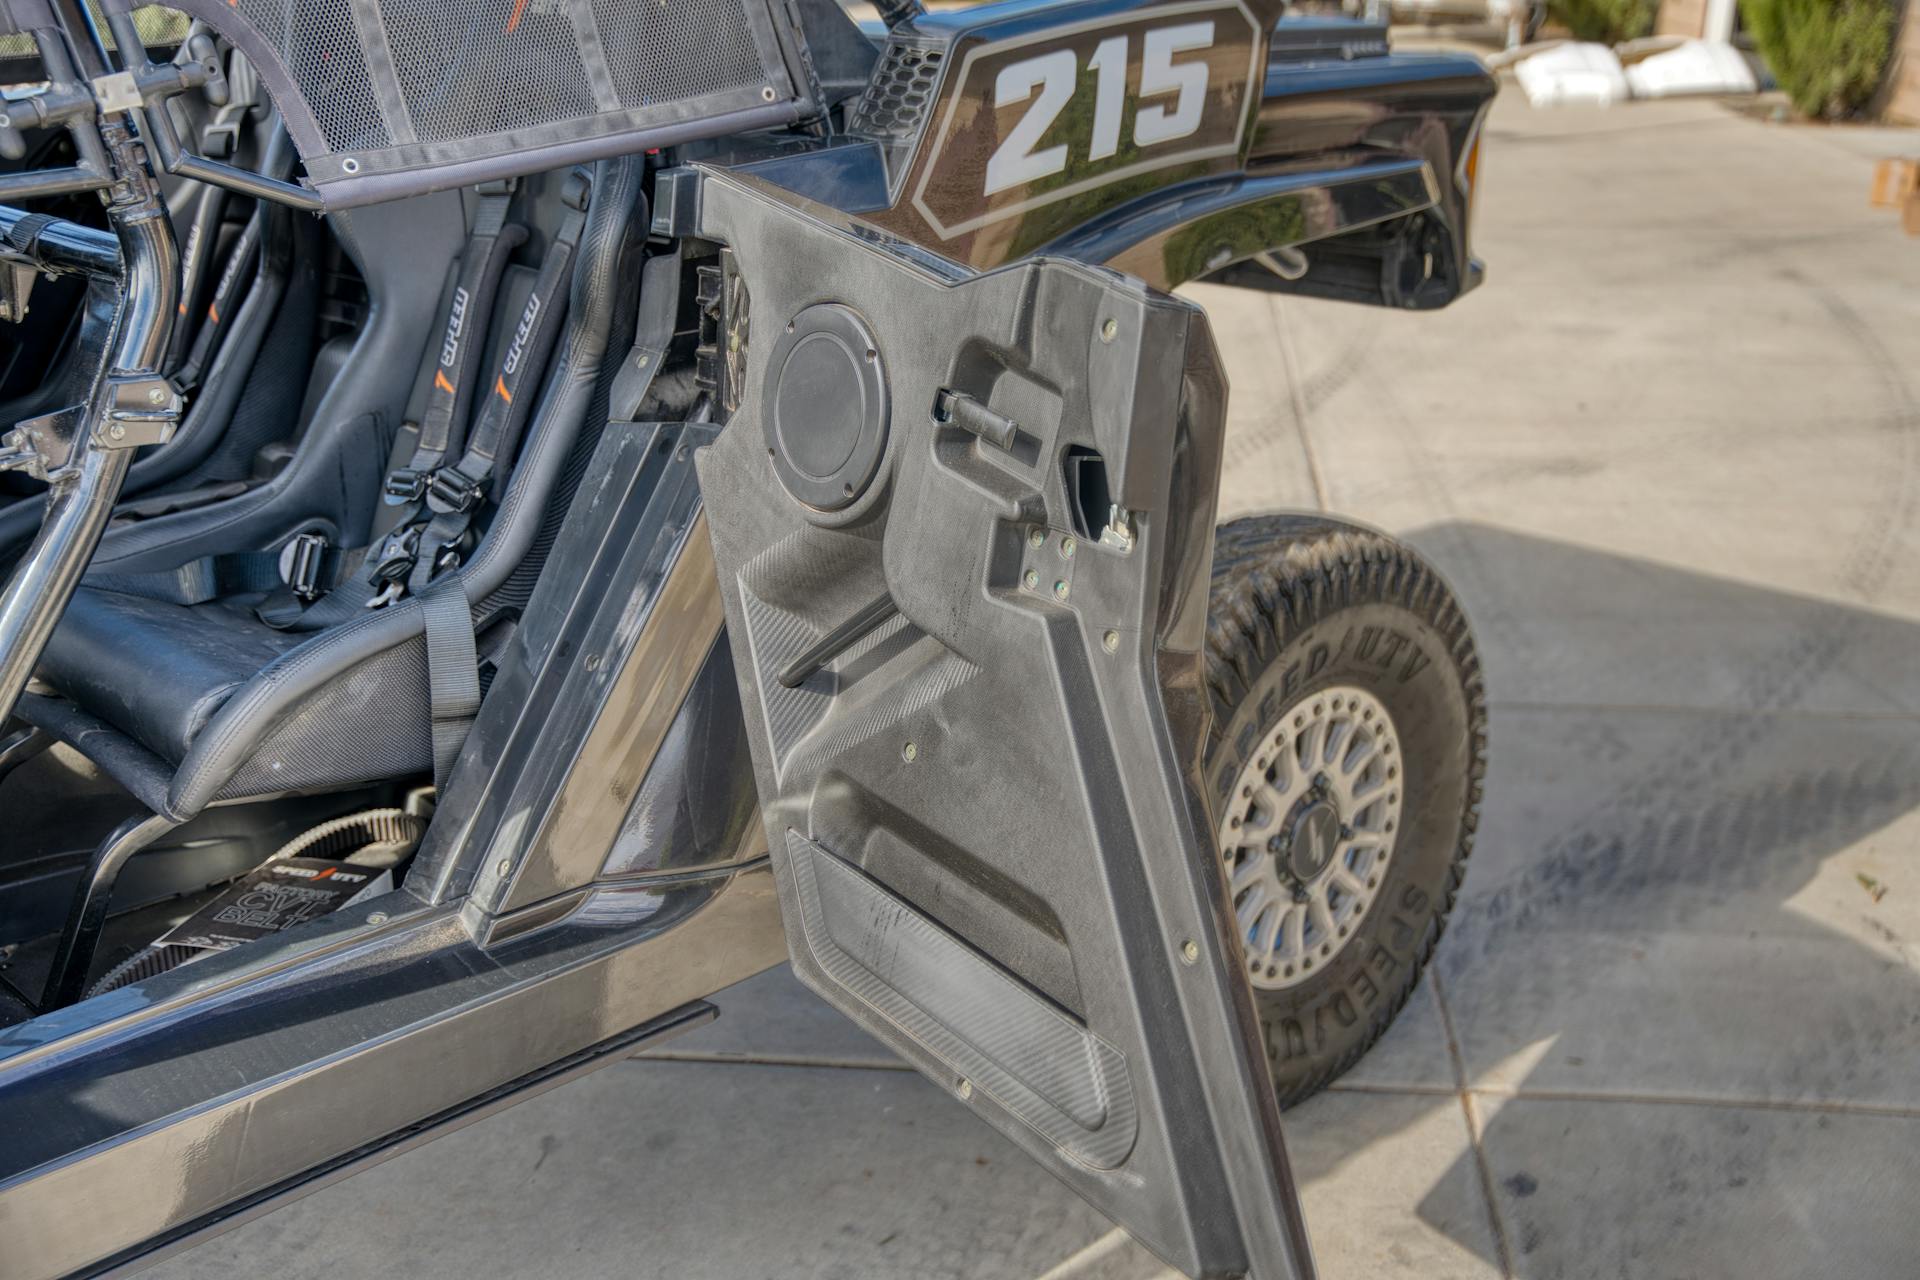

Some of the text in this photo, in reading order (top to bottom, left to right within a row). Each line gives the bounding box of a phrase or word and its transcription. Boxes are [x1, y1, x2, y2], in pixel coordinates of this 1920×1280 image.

[984, 21, 1215, 198] 215
[440, 286, 470, 368] SPEED
[503, 292, 541, 375] SPEED
[271, 865, 368, 883] SPEED UTV
[236, 891, 331, 916] CVT
[253, 881, 341, 900] FACTORY
[212, 904, 310, 930] BELT
